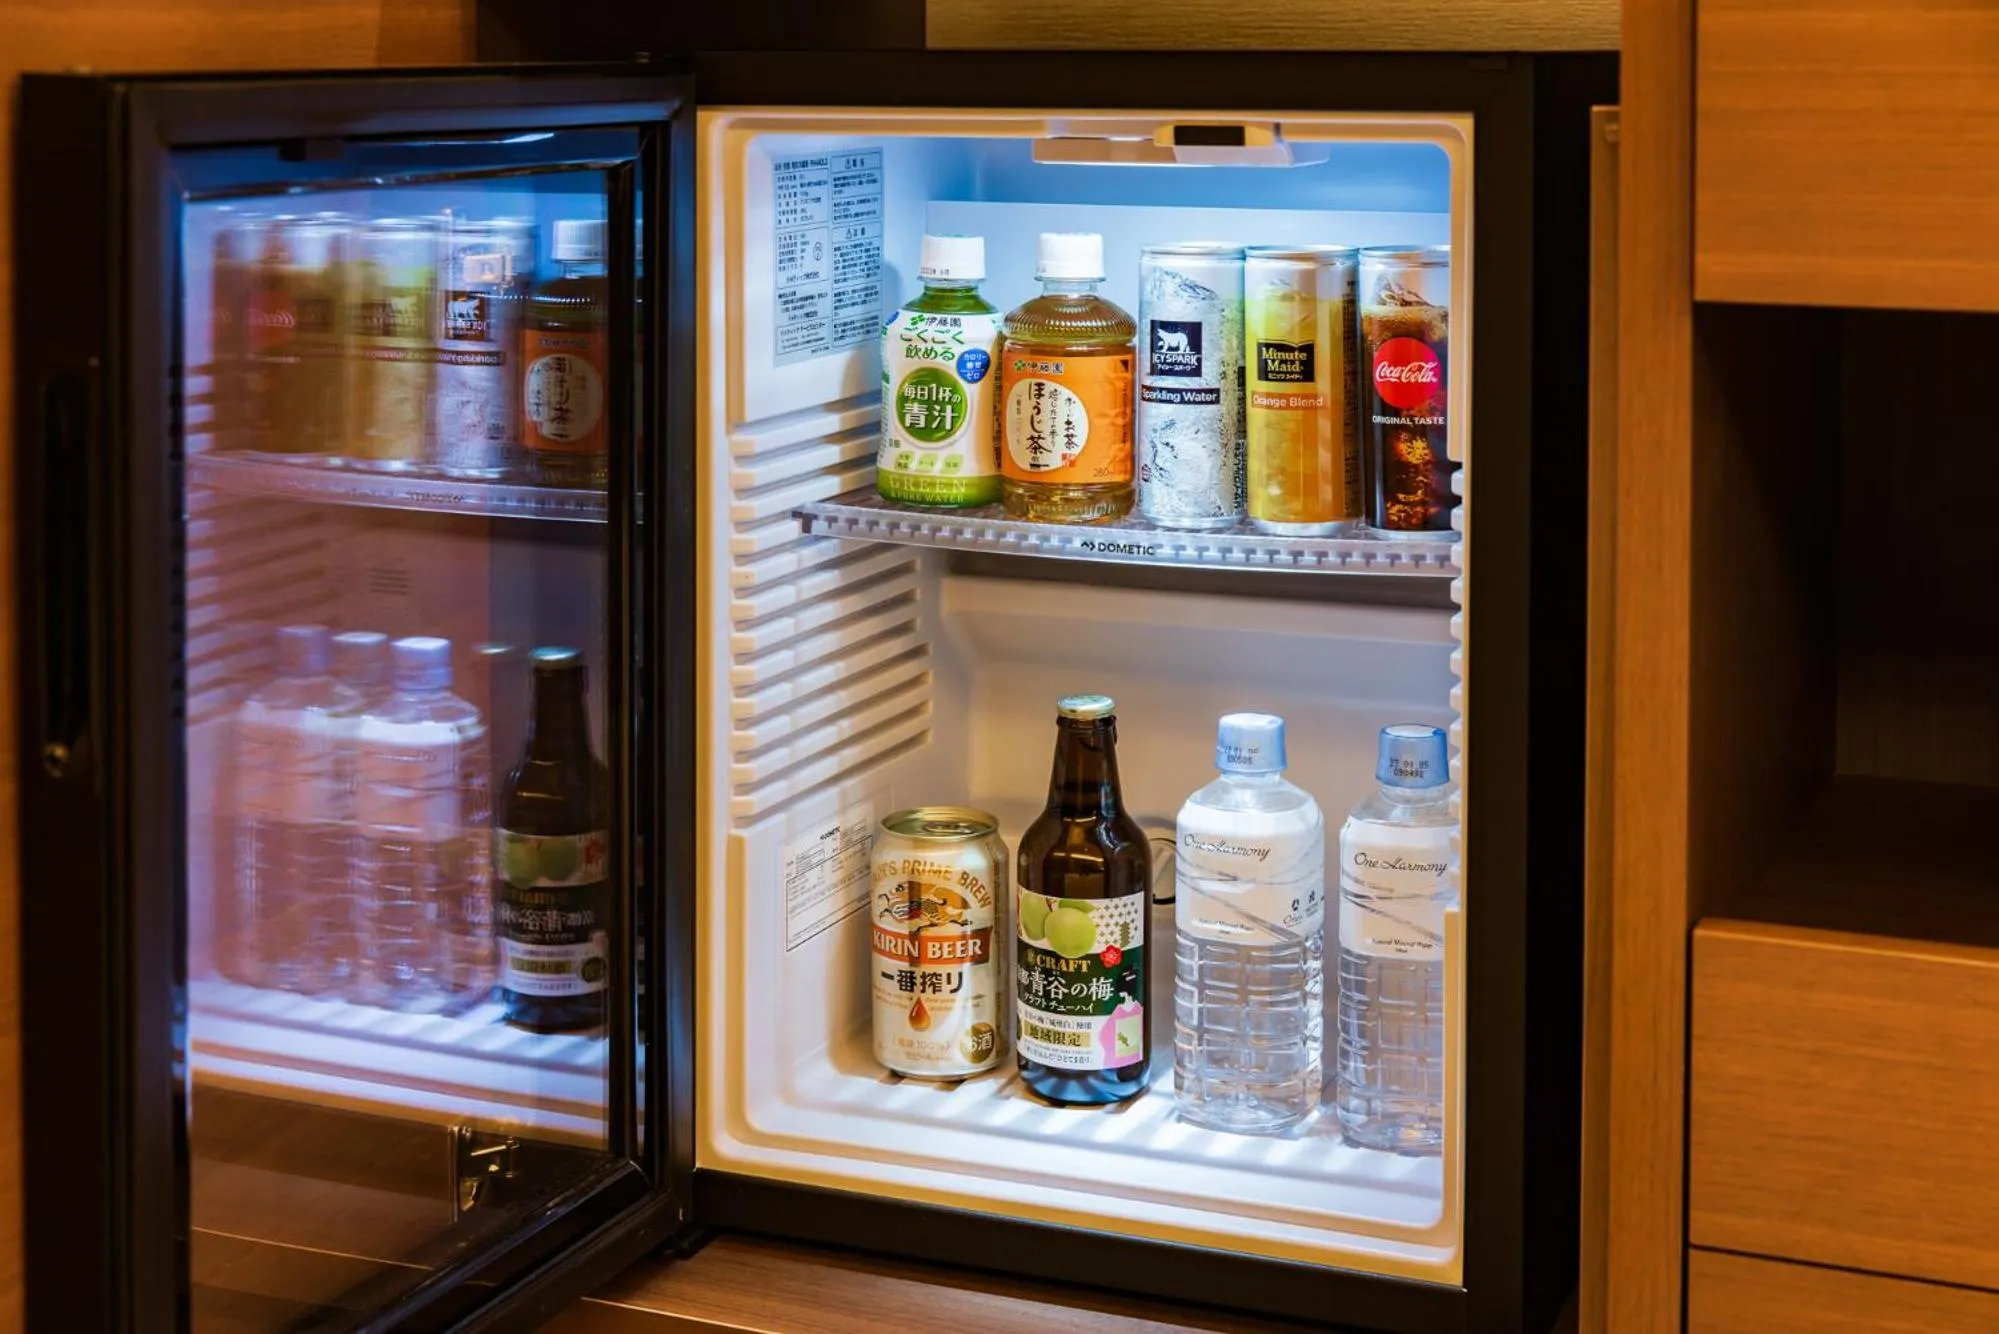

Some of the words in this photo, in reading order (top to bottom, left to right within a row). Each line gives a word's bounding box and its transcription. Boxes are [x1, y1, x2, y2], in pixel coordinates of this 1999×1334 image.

[925, 315, 962, 328] 伊藤園
[900, 326, 965, 345] ごくごく
[905, 345, 956, 362] 飲める
[1261, 347, 1308, 361] Minute
[966, 370, 981, 380] ゼロ
[1267, 359, 1301, 372] Maid
[1376, 360, 1439, 384] Coca-Cola
[903, 383, 962, 403] 毎日1杯の
[1182, 390, 1218, 402] Water
[1252, 394, 1287, 409] Orange
[1289, 396, 1324, 407] Blend
[902, 402, 959, 432] 青汁
[1026, 381, 1052, 455] ほうじ茶
[1372, 415, 1412, 426] ORIGINAL
[1413, 416, 1446, 426] TASTE
[888, 475, 968, 493] GREEN
[1097, 541, 1156, 556] DOMETIC
[1184, 833, 1206, 851] One
[1204, 838, 1272, 863] Harmony
[1354, 851, 1381, 869] One
[1379, 855, 1449, 878] Harmony
[901, 858, 954, 881] PRIME
[956, 870, 992, 909] BREW
[873, 929, 919, 958] KIRIN
[926, 938, 983, 960] BEER
[1036, 953, 1092, 973] CRAFT
[881, 969, 964, 995] 一番搾り
[1030, 971, 1115, 1002] 青谷の梅
[1029, 1022, 1082, 1047] 地域限定
